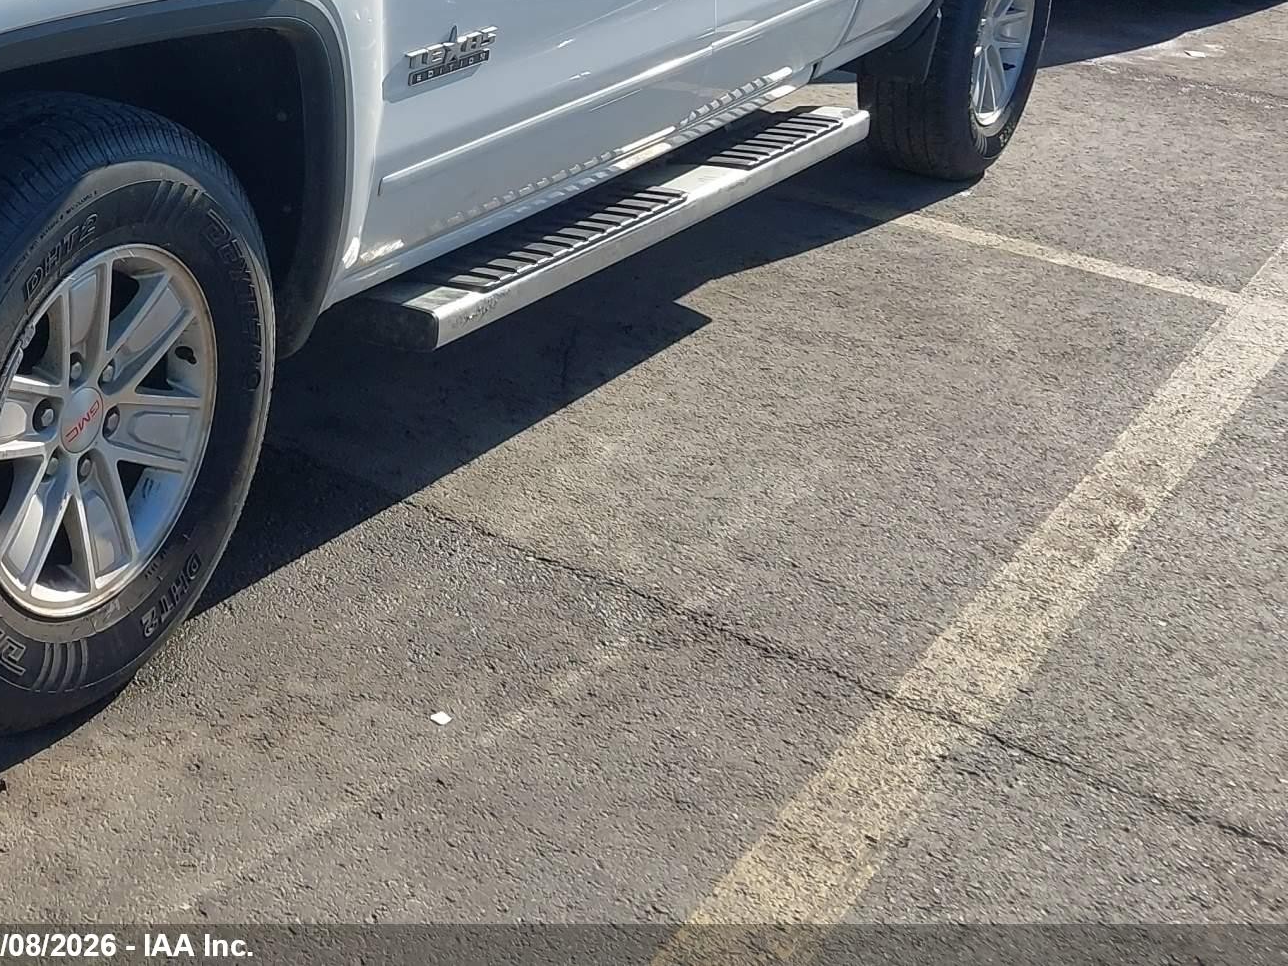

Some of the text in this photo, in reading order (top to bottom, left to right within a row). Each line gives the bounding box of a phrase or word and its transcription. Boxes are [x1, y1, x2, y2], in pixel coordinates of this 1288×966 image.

[405, 24, 499, 69] TEXAS
[415, 51, 488, 83] EDITION
[65, 400, 100, 443] GMC
